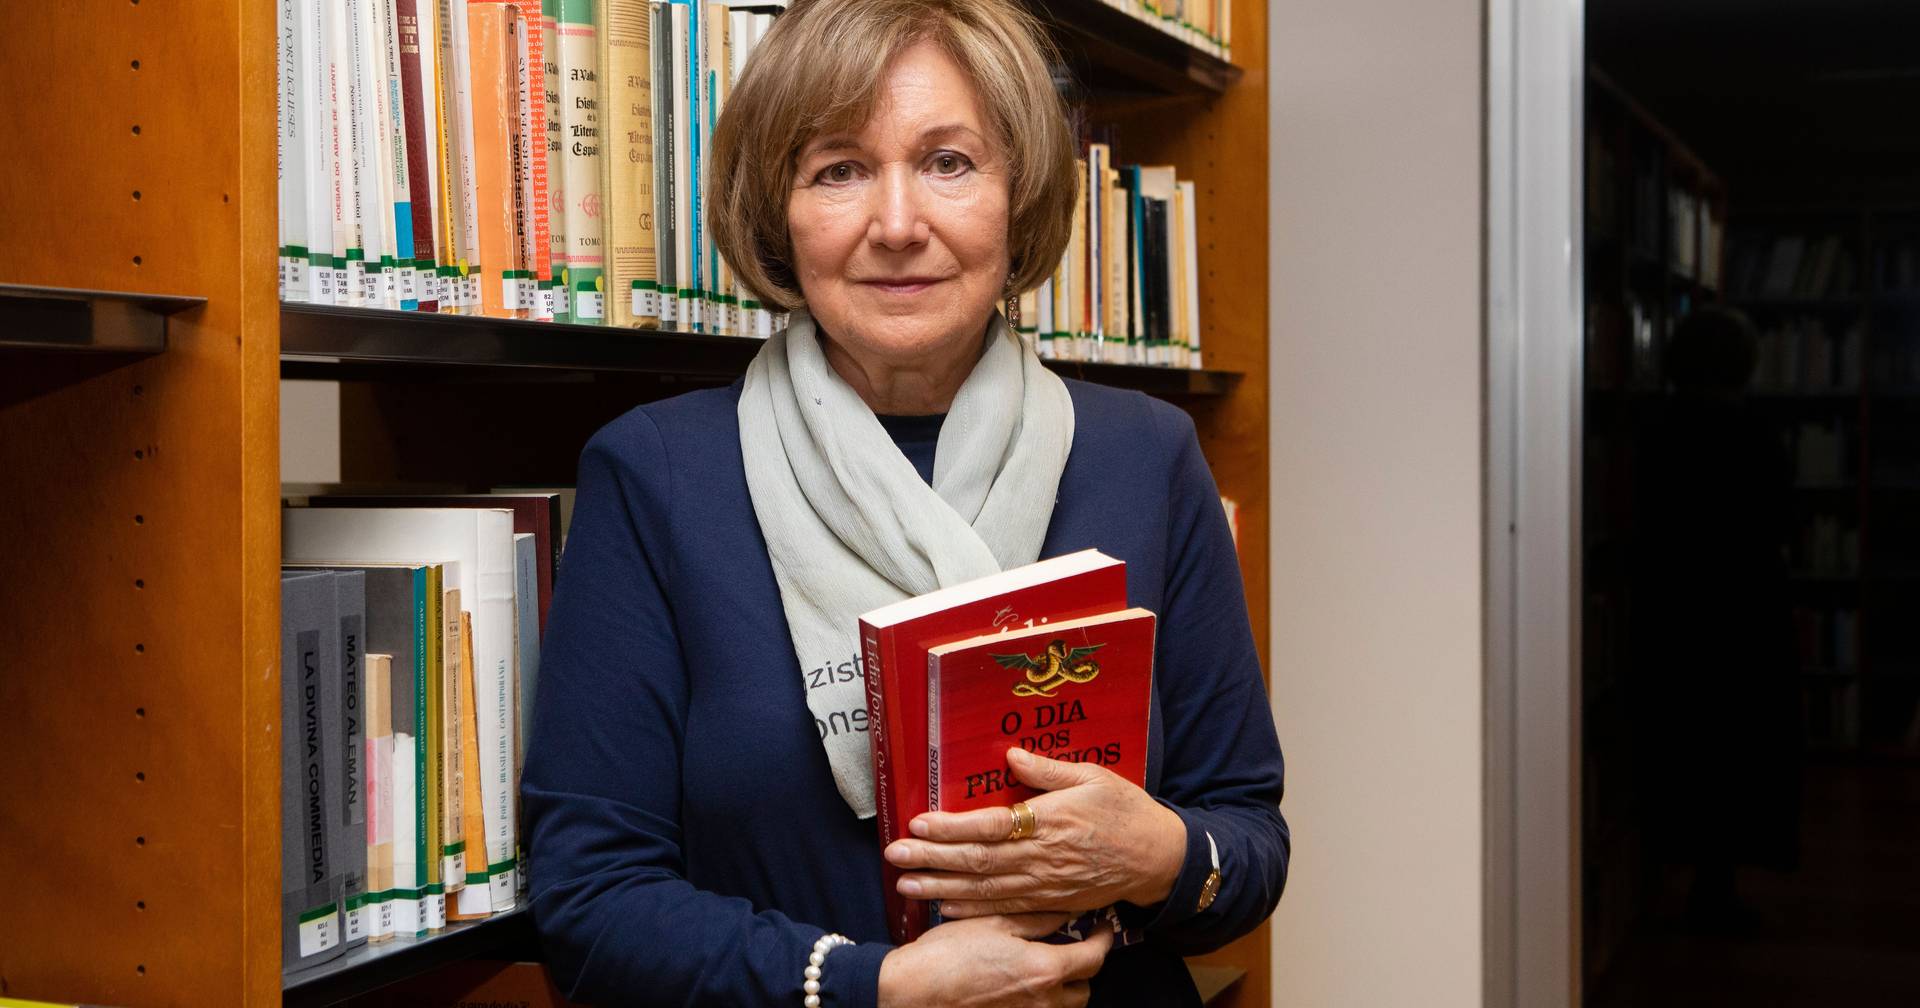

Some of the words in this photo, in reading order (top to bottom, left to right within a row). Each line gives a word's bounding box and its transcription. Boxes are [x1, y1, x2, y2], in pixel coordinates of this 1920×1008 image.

[285, 26, 296, 139] PORTUGUESES
[332, 108, 338, 121] DE
[519, 57, 528, 181] PERSPECTIVAS
[334, 161, 340, 176] DO
[513, 133, 525, 236] PERSPECTIVAS
[303, 651, 314, 680] LA
[347, 634, 356, 711] MATEO
[866, 637, 881, 686] Lídia
[304, 685, 319, 759] DIVINA
[420, 695, 425, 708] DE
[867, 683, 884, 742] Jorge
[1001, 711, 1022, 736] O
[1034, 698, 1087, 729] DIA
[878, 750, 886, 768] Os
[1020, 729, 1071, 752] DOS
[308, 763, 324, 884] COMMEDIA
[501, 825, 507, 836] DA
